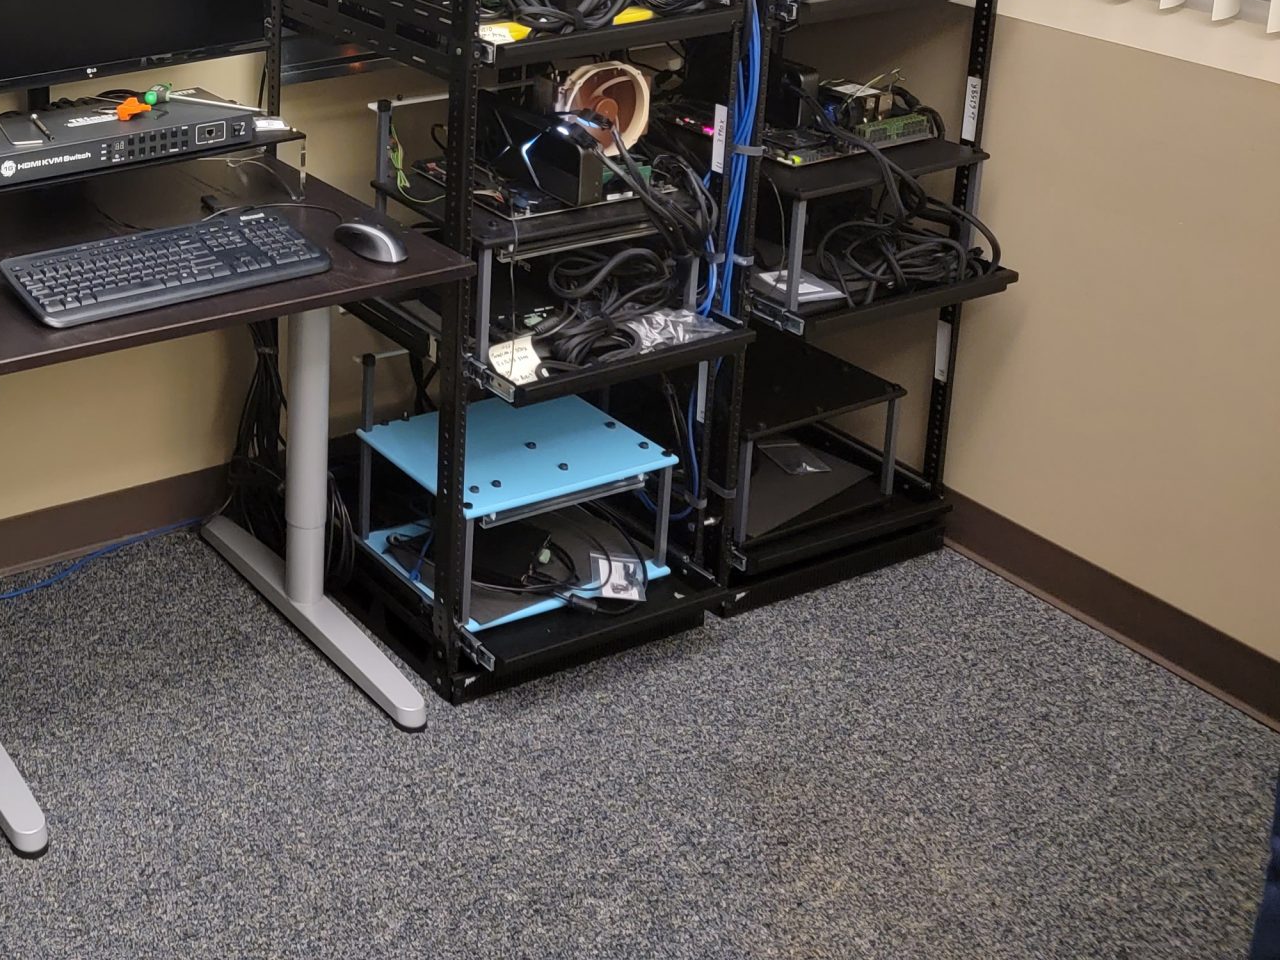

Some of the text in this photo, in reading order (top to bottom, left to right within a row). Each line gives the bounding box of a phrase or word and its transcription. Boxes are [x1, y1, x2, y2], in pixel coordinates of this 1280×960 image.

[18, 152, 92, 170] HDMI KVM Switch
